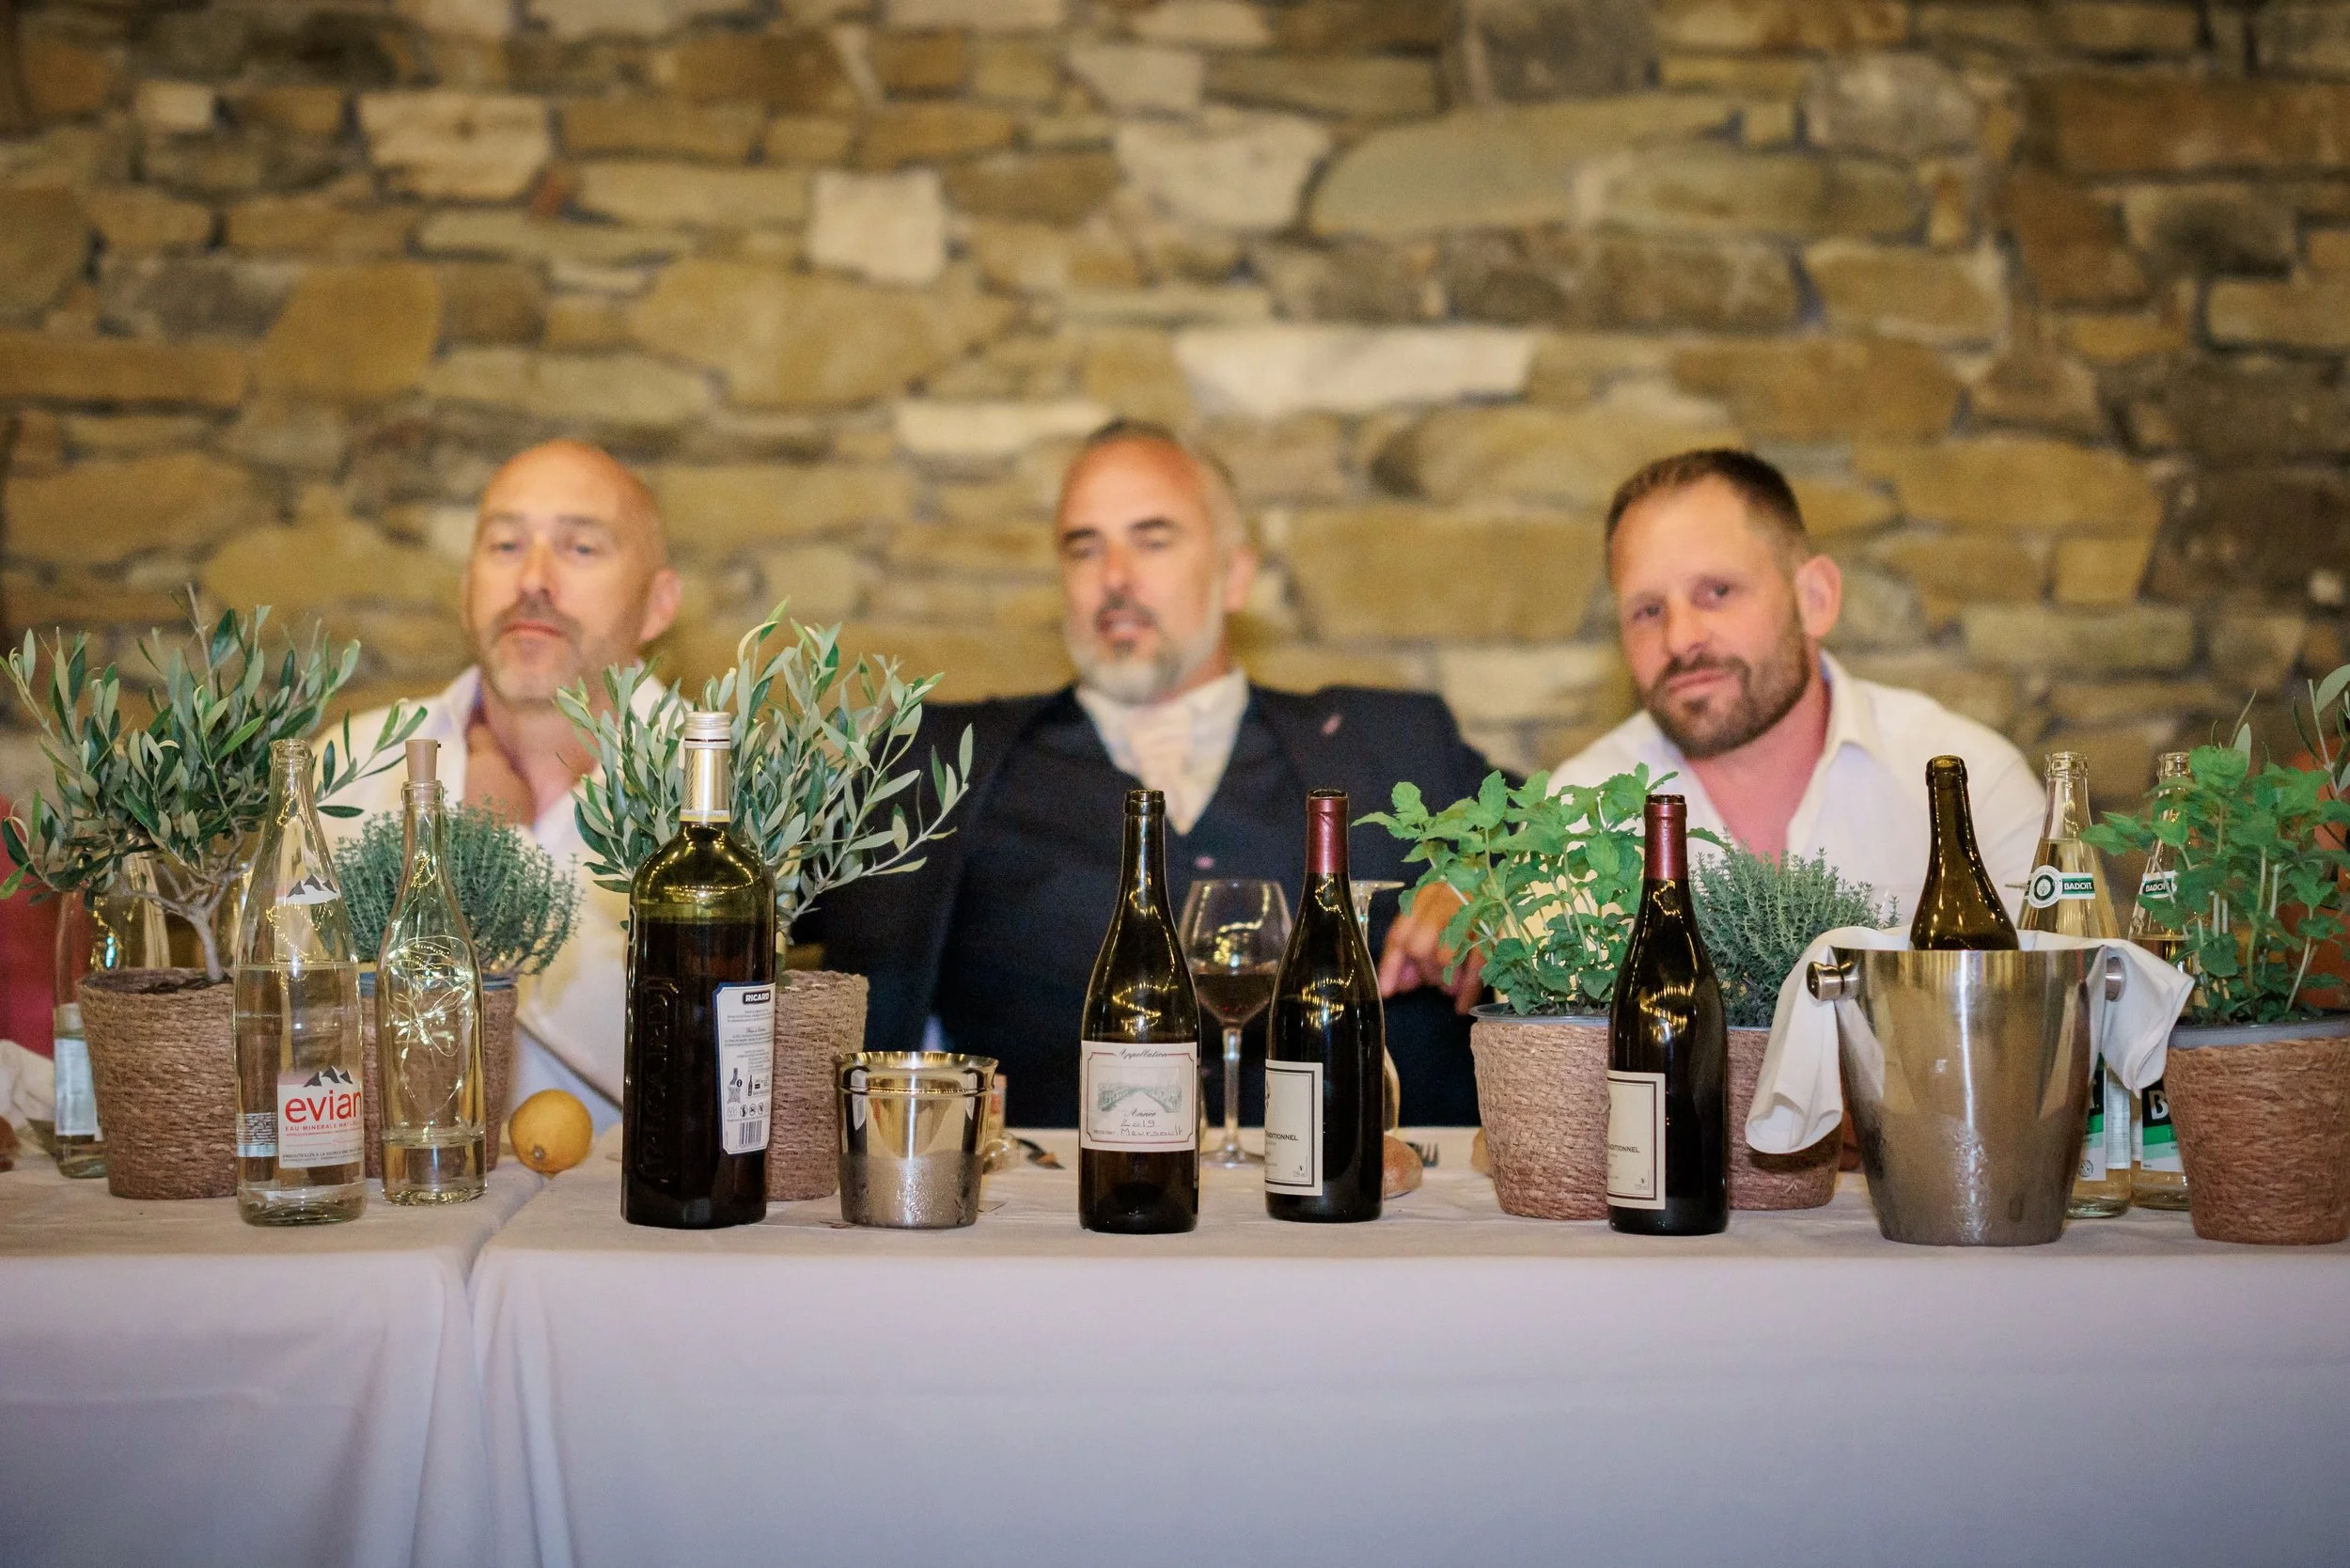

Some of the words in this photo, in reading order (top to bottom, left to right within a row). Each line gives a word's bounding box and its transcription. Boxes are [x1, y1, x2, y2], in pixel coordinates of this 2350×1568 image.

[744, 992, 770, 1002] RICARD
[1120, 1048, 1167, 1059] Appellation
[285, 1090, 362, 1122] evian
[1120, 1119, 1155, 1128] 2019
[1120, 1124, 1183, 1137] Meursault
